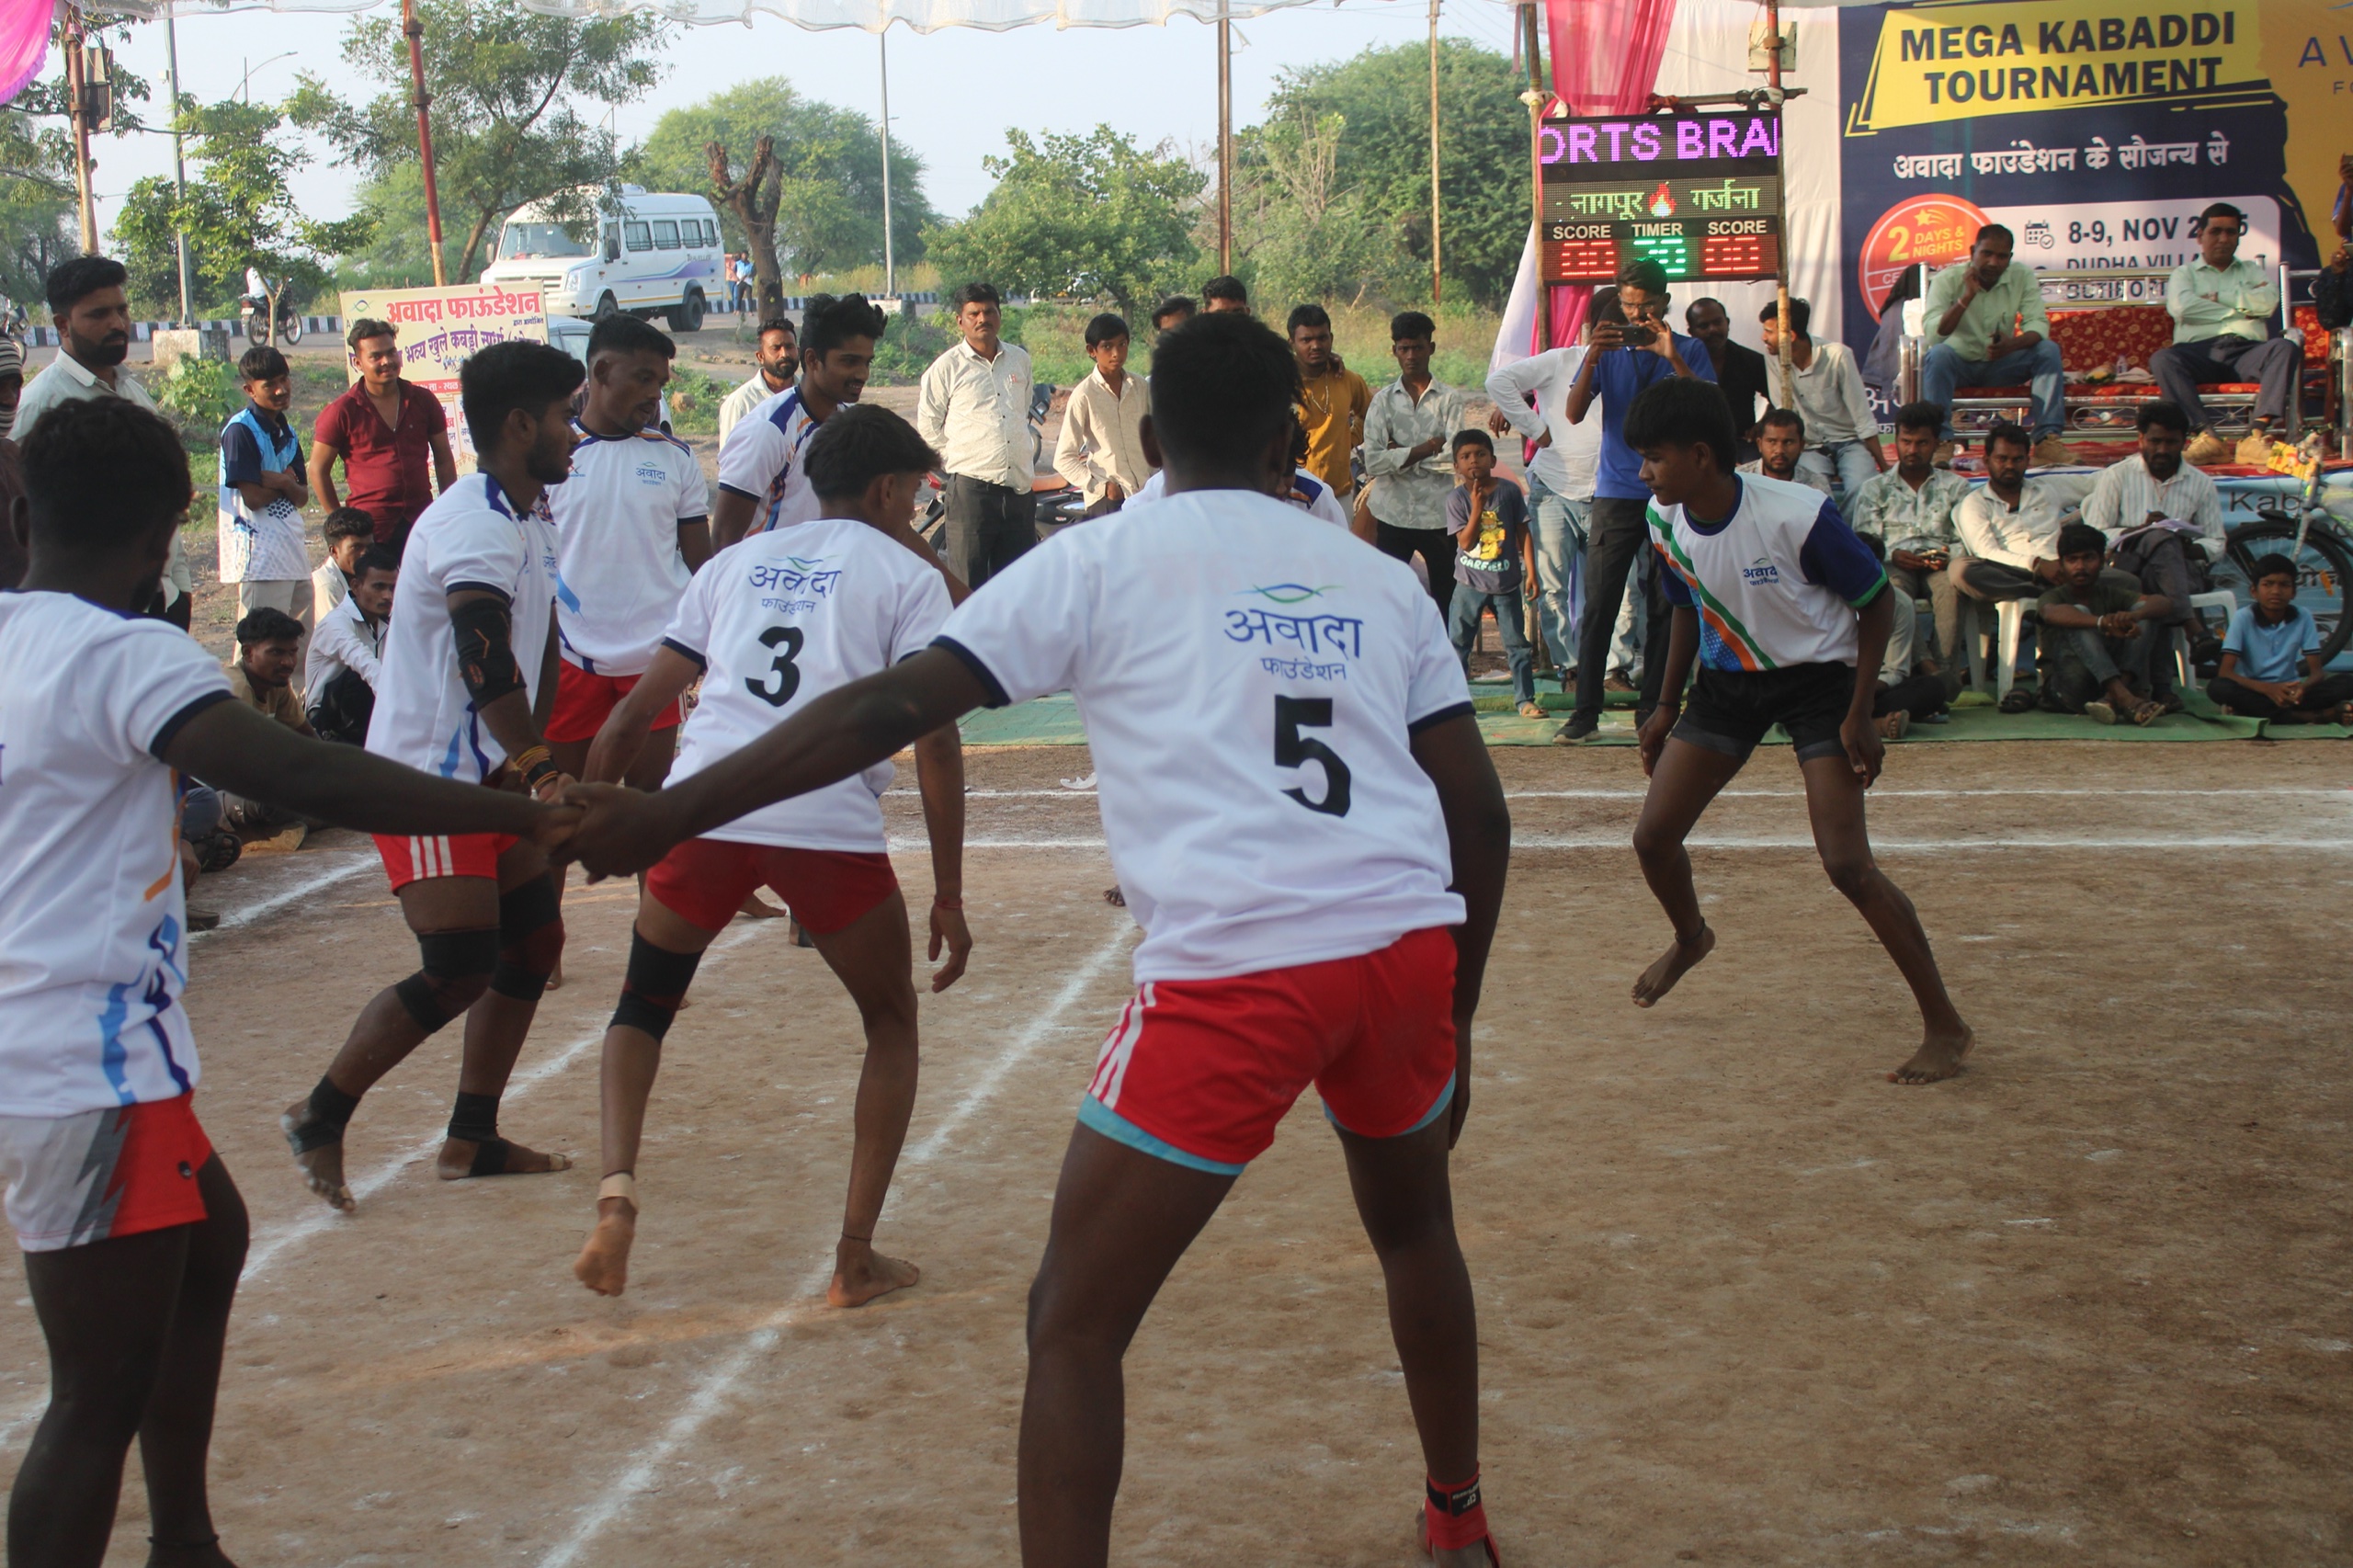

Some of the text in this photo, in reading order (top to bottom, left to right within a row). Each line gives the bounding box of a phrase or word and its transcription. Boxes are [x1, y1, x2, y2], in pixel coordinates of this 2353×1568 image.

[1901, 11, 2235, 62] MEGA KABADDI
[1924, 57, 2222, 105] TOURNAMENT
[1677, 118, 1778, 160] BRA
[1893, 131, 2230, 179] अवादा फाउंडेशन के सौजन्य से
[1570, 178, 1761, 221] नागपूर गर्जना
[1553, 224, 1611, 239] SCORE
[1631, 222, 1683, 237] TIMER
[1708, 220, 1767, 235] SCORE
[1888, 226, 1909, 262] 2
[1915, 225, 1964, 244] DAYS &
[2069, 213, 2248, 247] 8-9, NOV 25
[1913, 239, 1963, 257] NIGHTS
[386, 300, 443, 324] अवादा
[405, 340, 426, 363] भव्य
[428, 326, 448, 363] खुले
[636, 467, 665, 481] अवादा
[1460, 555, 1510, 573] GARFIELD
[1743, 565, 1779, 578] अवाद
[749, 565, 842, 598] अवादा
[1224, 608, 1364, 660] अवादा
[745, 626, 804, 708] 3
[1260, 656, 1347, 681] फाउंडेशन
[1274, 694, 1351, 818] 5
